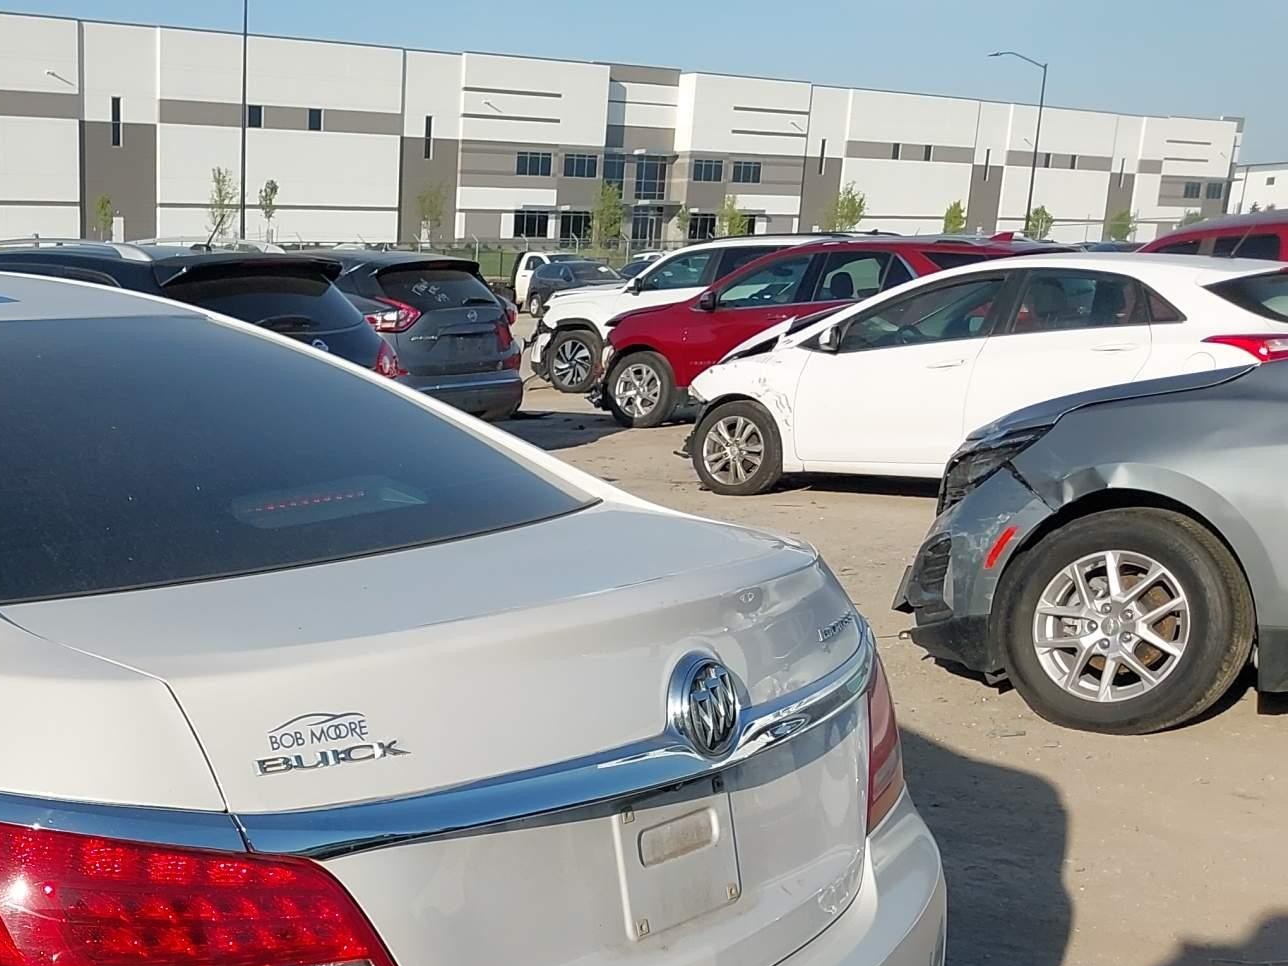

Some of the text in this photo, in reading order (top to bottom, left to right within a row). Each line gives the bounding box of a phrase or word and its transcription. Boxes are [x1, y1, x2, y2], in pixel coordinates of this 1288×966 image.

[268, 718, 369, 751] BOB MOORE
[253, 739, 412, 777] BUICK
